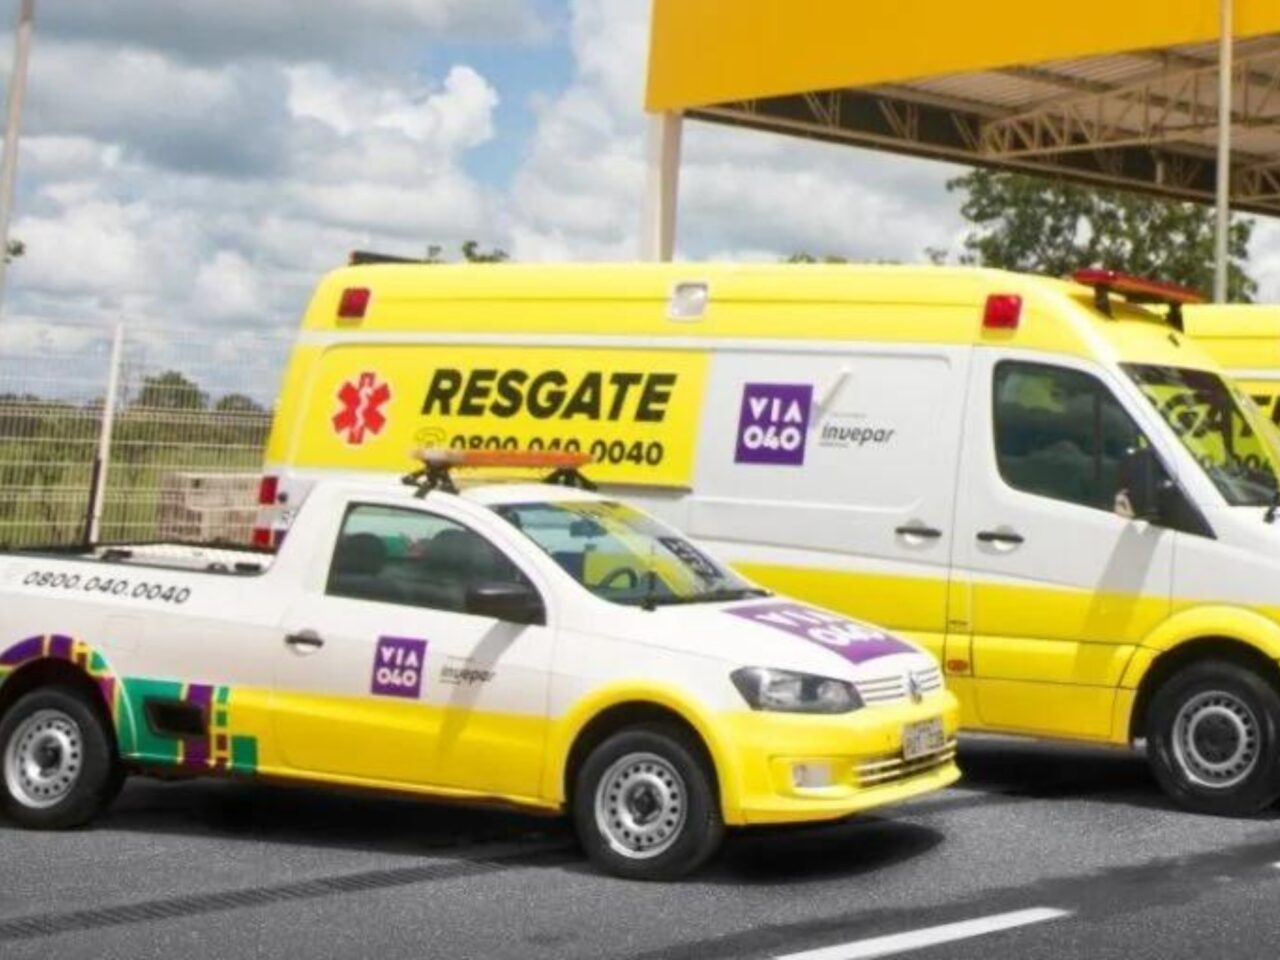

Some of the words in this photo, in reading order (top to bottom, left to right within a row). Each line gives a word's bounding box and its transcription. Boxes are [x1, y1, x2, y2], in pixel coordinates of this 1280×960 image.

[420, 368, 678, 422] RESGATE
[749, 397, 803, 423] VIA
[742, 425, 802, 451] 040
[821, 422, 895, 446] invepar
[22, 571, 192, 605] 0800.040.0040
[381, 646, 419, 667] VIA
[376, 668, 418, 688] 040
